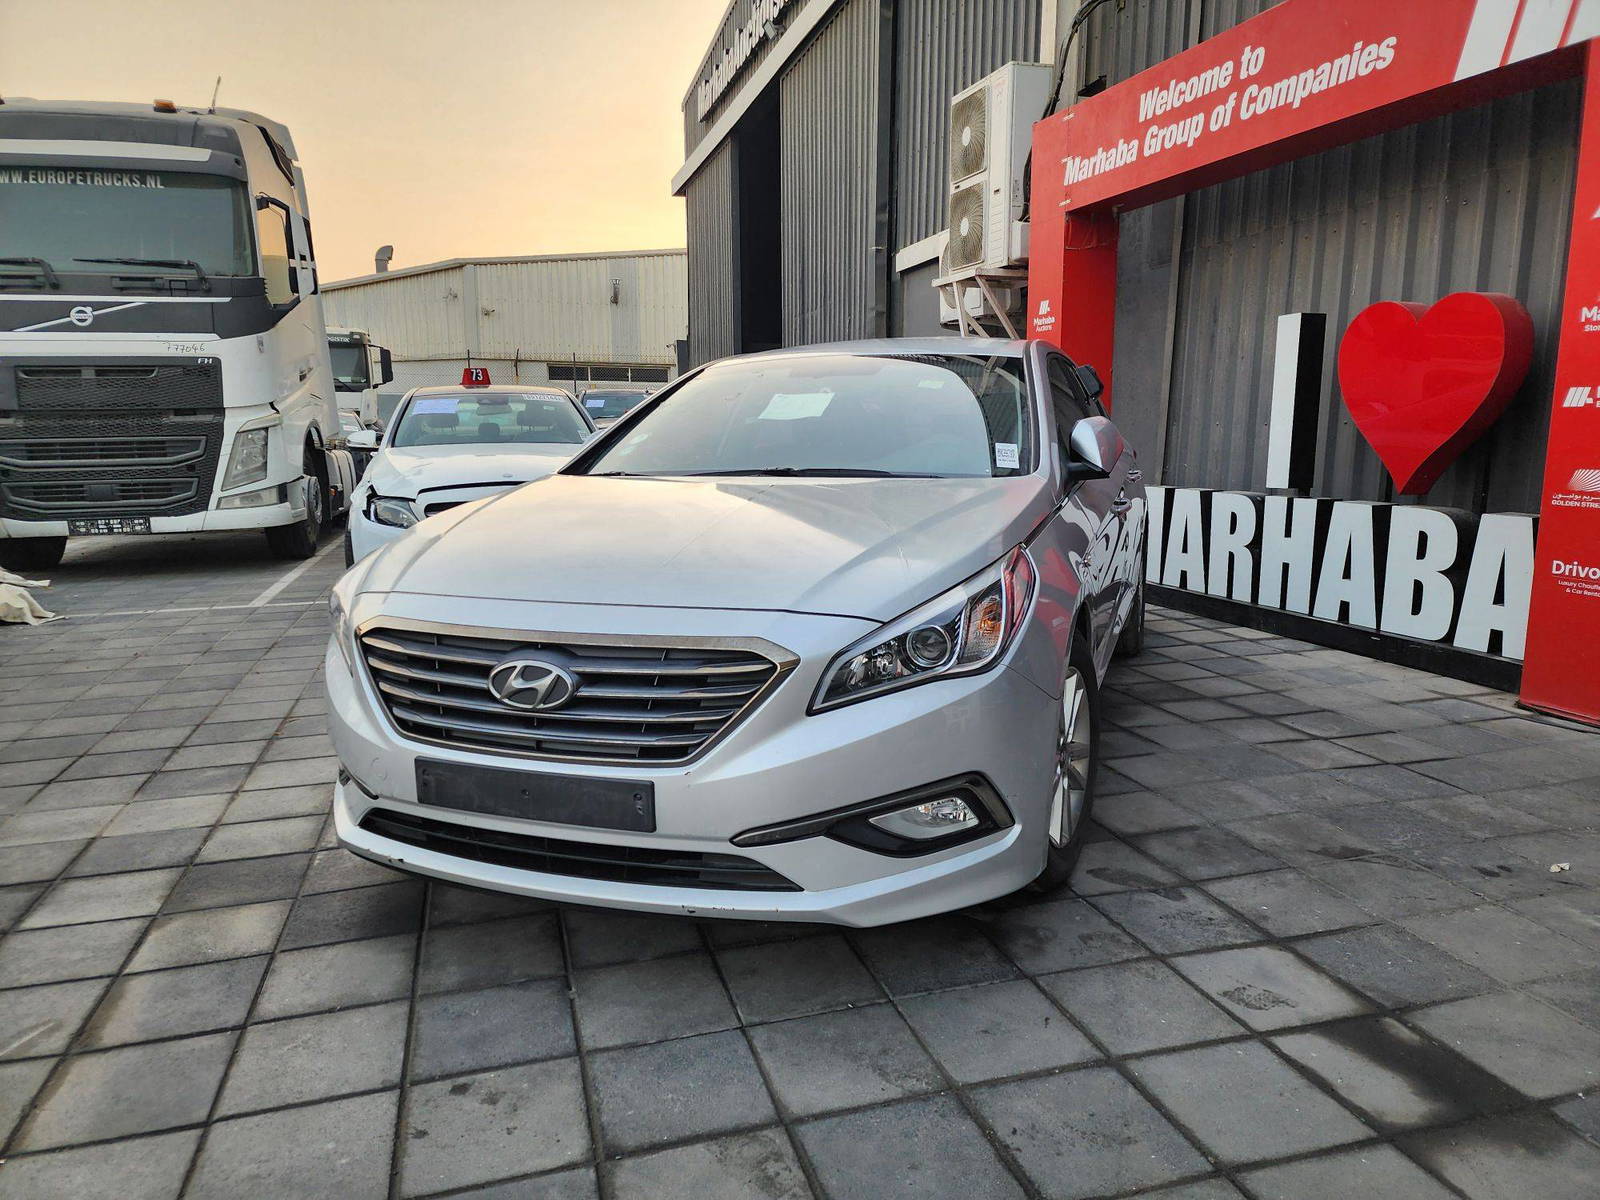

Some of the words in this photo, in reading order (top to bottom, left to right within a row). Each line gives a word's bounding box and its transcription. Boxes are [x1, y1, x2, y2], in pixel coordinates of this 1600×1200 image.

[1138, 60, 1234, 123] Welcome
[1239, 45, 1266, 81] to
[1063, 138, 1140, 187] Marhaba
[1143, 112, 1205, 158] Group
[1209, 91, 1238, 133] of
[1239, 36, 1398, 120] Companies
[470, 369, 483, 381] 73
[1266, 313, 1303, 489] I
[1552, 499, 1580, 507] GOLDEN
[1558, 580, 1577, 588] Luxury
